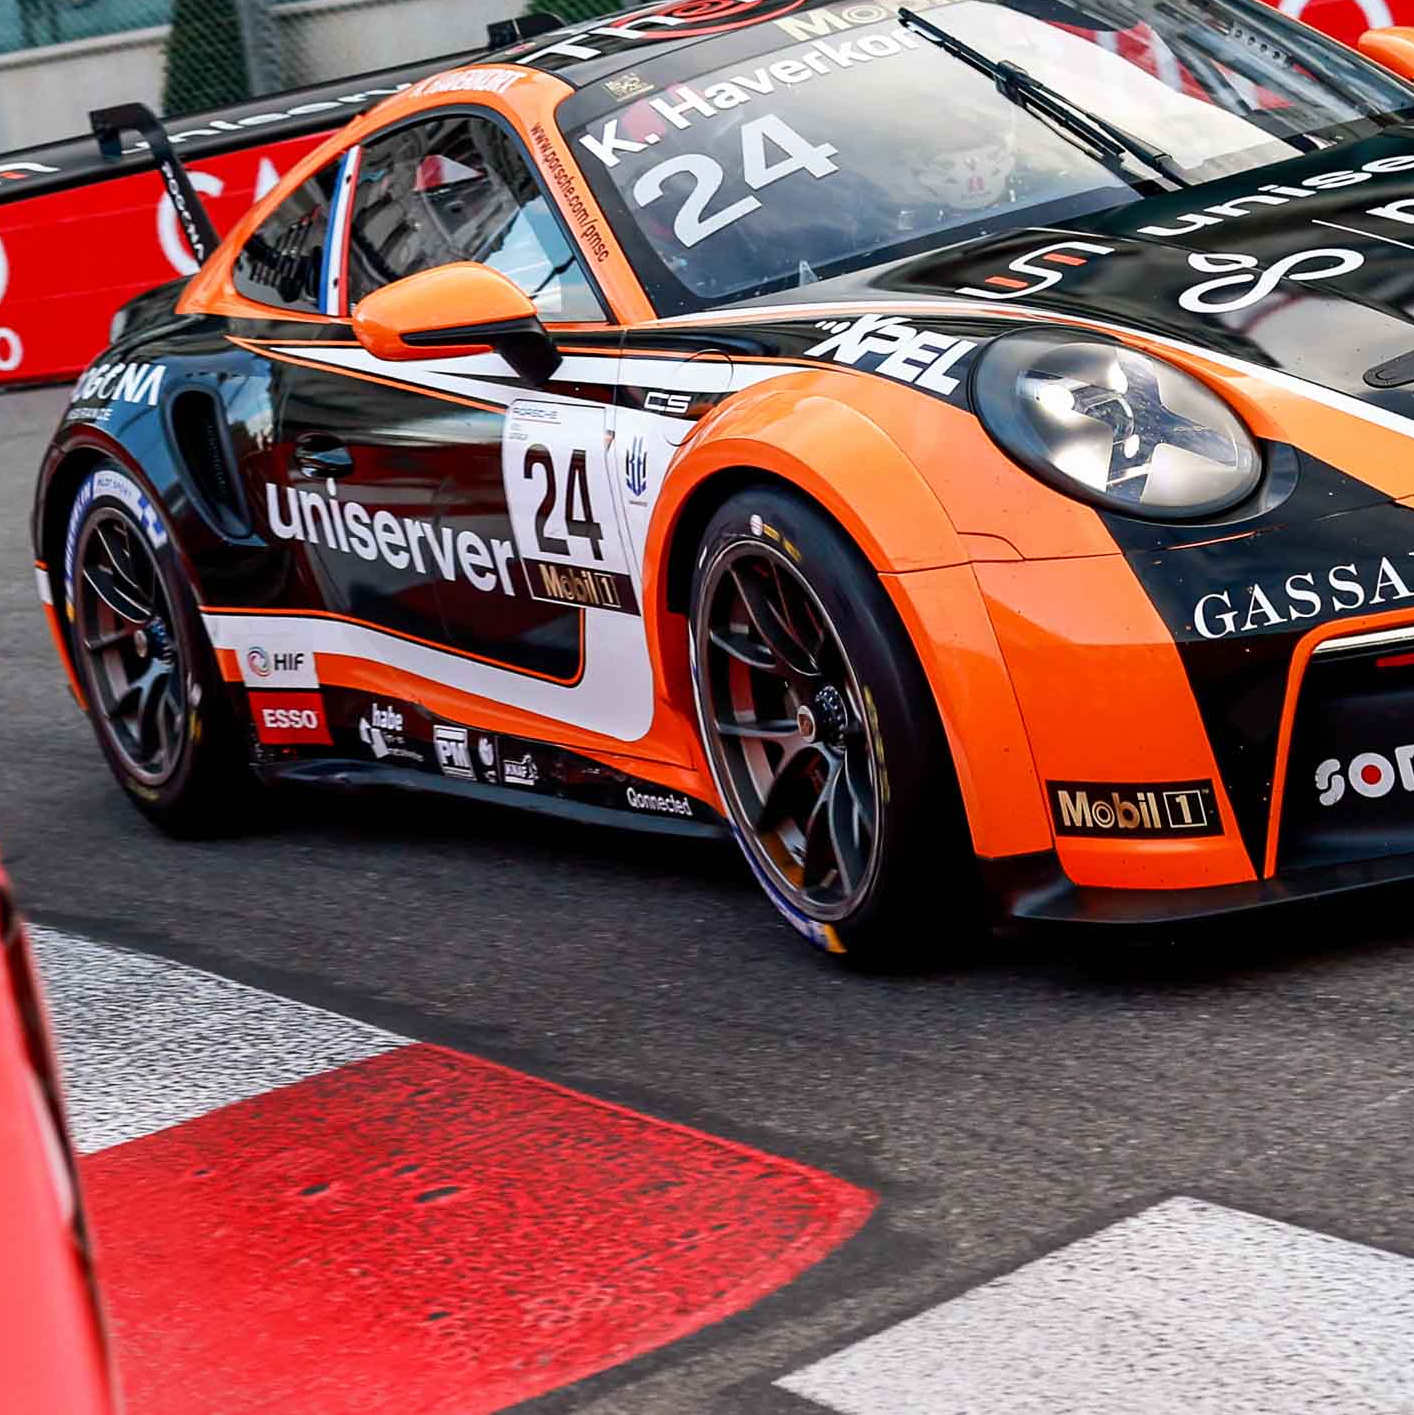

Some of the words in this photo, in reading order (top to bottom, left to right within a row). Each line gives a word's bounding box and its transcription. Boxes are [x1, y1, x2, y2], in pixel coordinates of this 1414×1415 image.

[579, 118, 661, 168] K.
[649, 23, 925, 131] Haverkor
[529, 121, 610, 263] www.porsche.com/pmsc
[632, 112, 839, 249] 24
[803, 313, 978, 396] XPEL
[266, 476, 516, 596] uniserver
[523, 443, 604, 561] 24
[538, 563, 601, 605] Mobil
[274, 653, 304, 671] HIF
[262, 708, 318, 729] ESSO
[1056, 788, 1162, 829] Mobil
